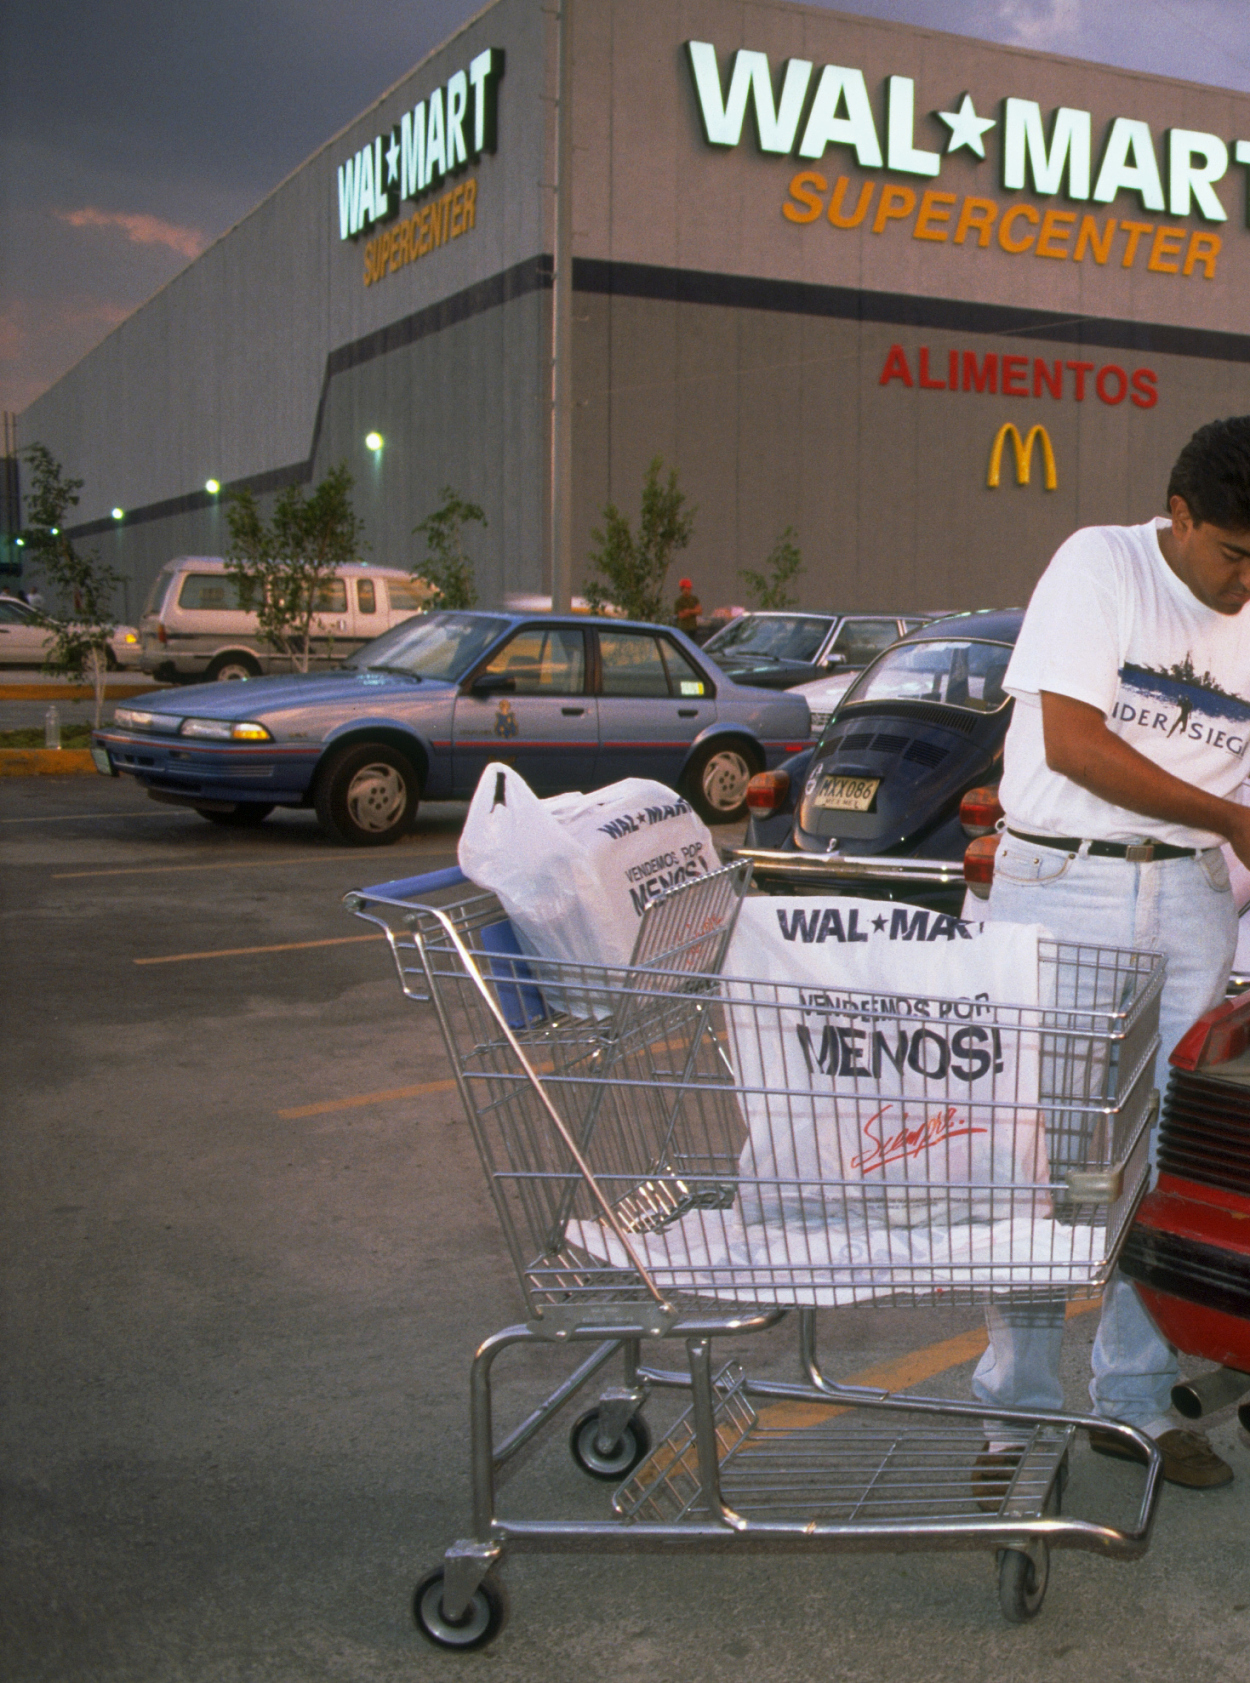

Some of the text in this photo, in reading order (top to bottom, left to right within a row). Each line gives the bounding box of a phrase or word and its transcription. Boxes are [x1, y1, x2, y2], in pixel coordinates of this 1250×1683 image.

[363, 177, 477, 287] SUPERCENTER
[781, 171, 1222, 279] SUPERCENTER
[879, 343, 1159, 408] ALIMENTOS
[624, 851, 680, 884] VENDEMOS
[800, 992, 932, 1023] VENDEMOS
[796, 1024, 1005, 1083] MENOS!
